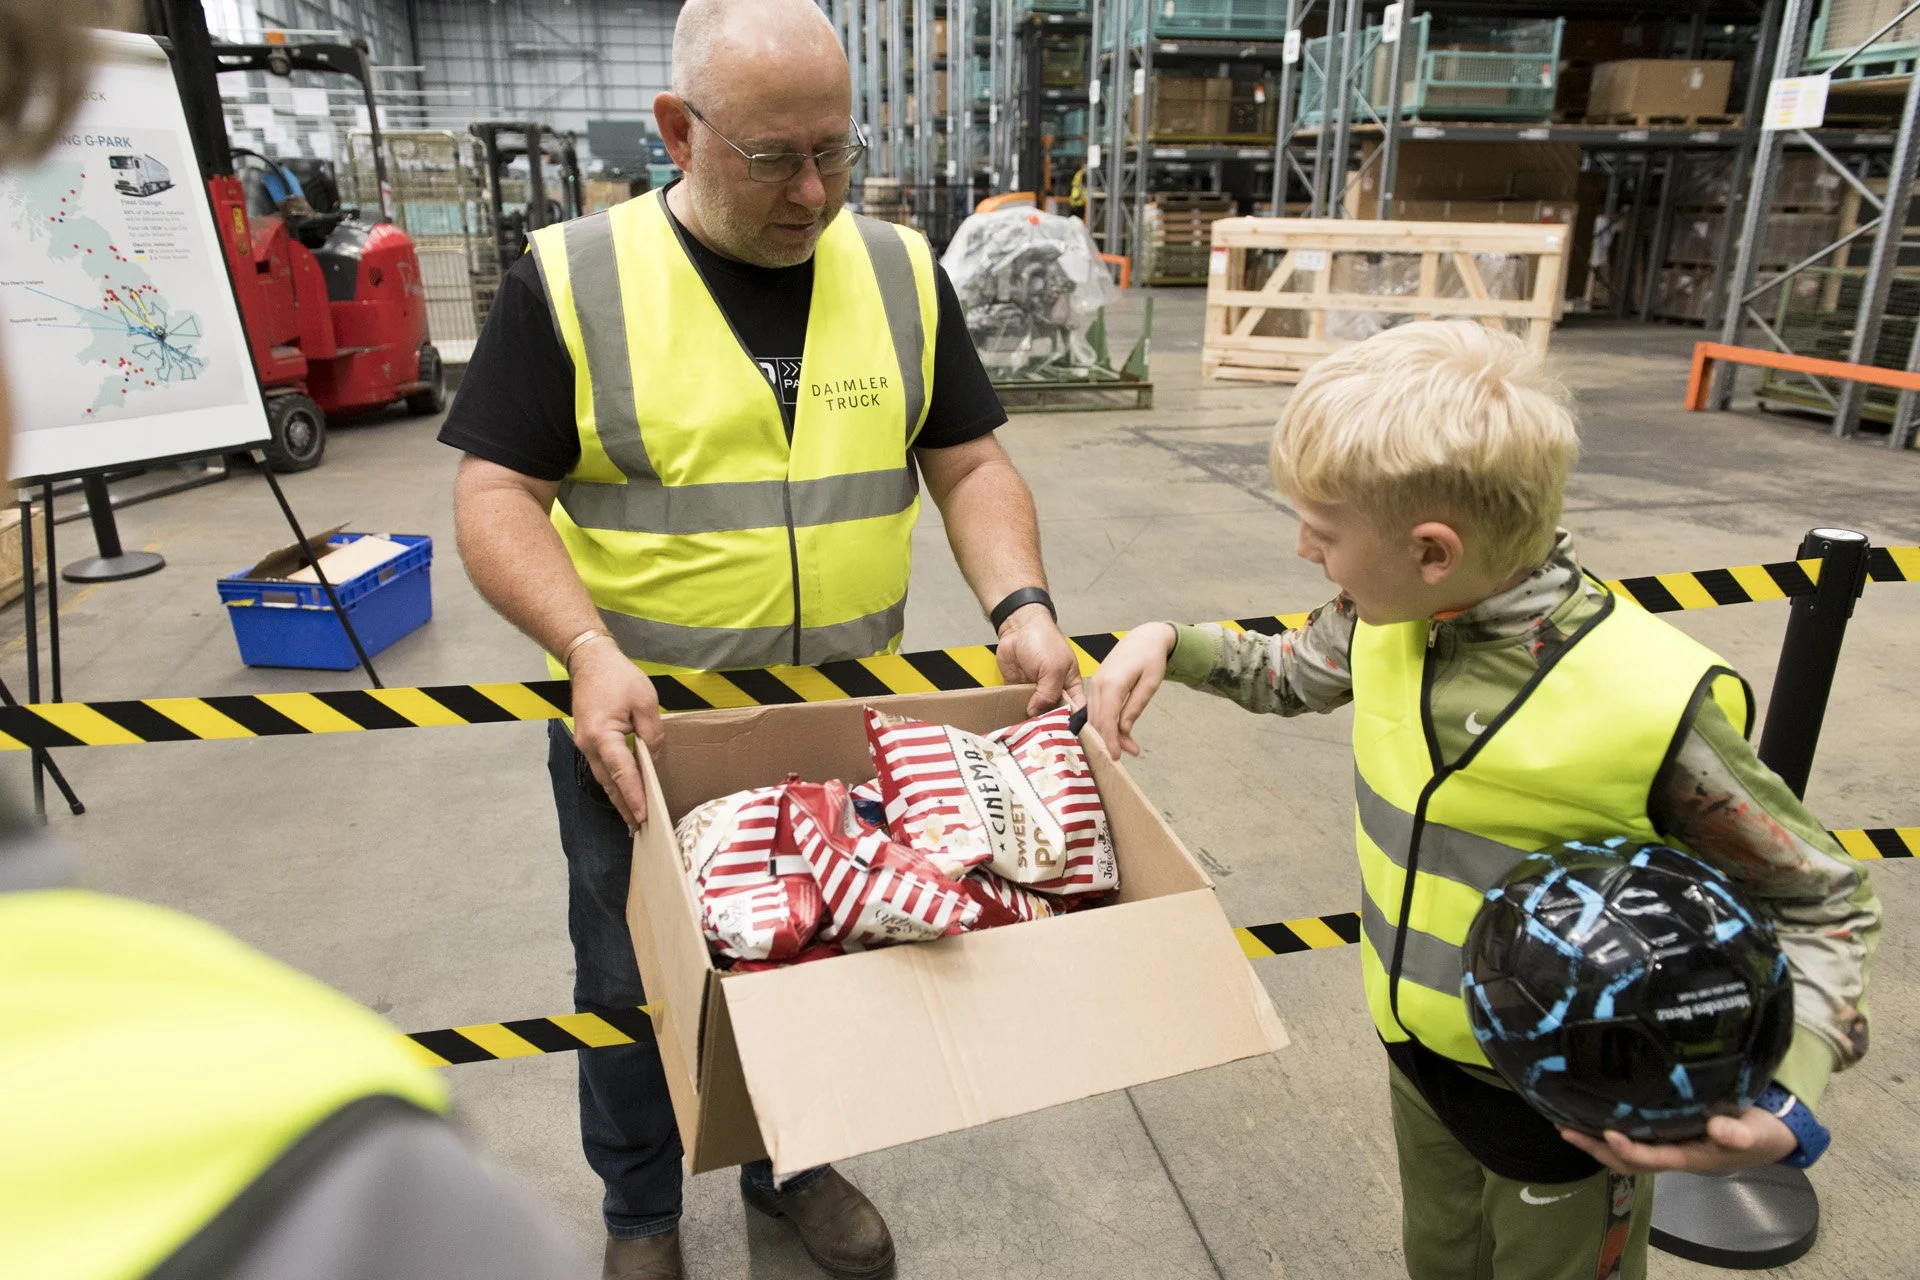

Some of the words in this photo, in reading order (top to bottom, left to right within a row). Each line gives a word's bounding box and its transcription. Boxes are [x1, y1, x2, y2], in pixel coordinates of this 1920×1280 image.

[84, 135, 133, 148] G-PARK
[811, 376, 889, 397] DAIMLER
[825, 393, 881, 412] TRUCK
[963, 749, 1006, 835] CINEMA
[1010, 798, 1028, 869] SWEET
